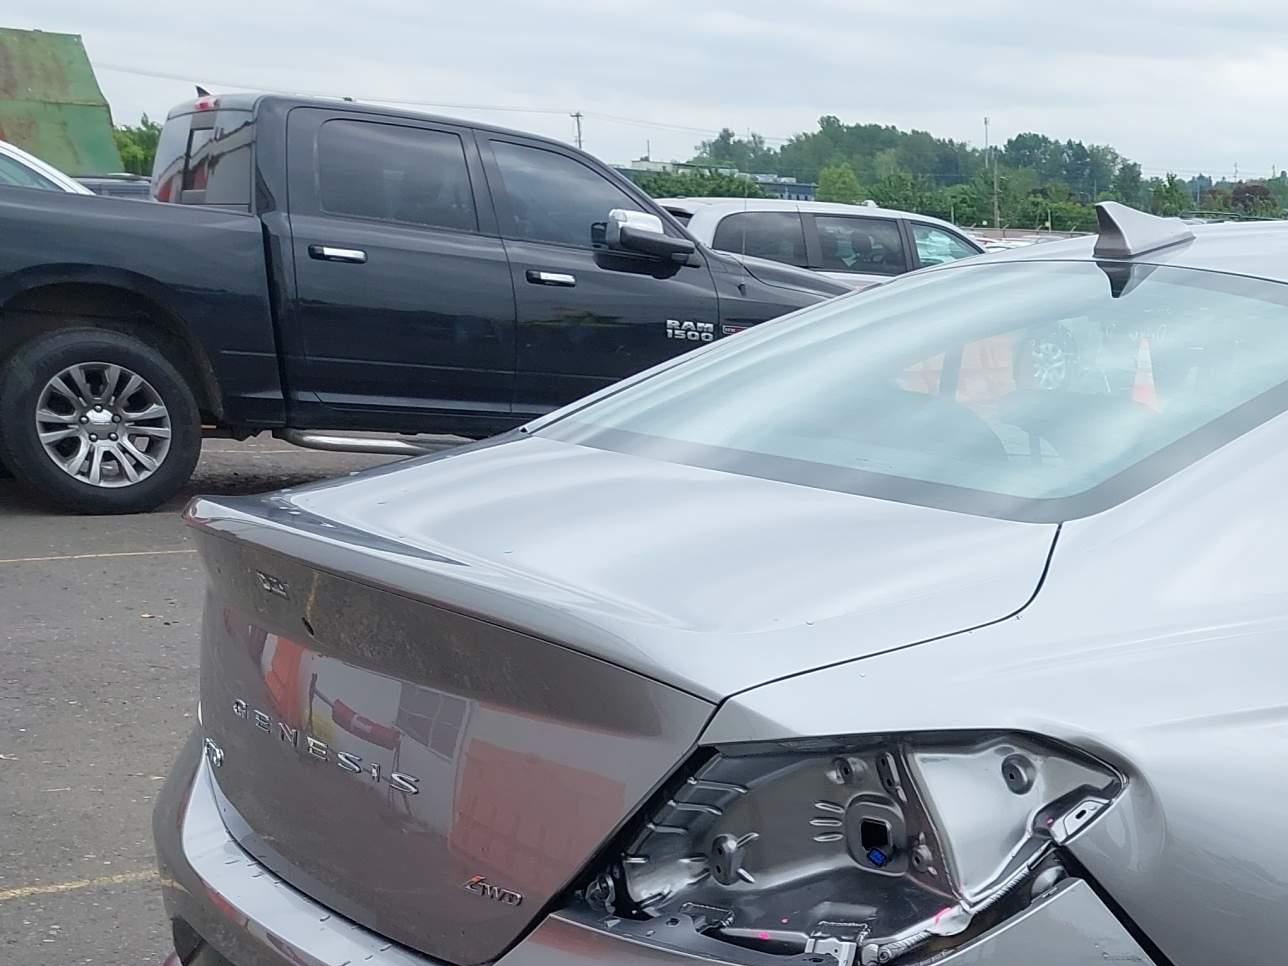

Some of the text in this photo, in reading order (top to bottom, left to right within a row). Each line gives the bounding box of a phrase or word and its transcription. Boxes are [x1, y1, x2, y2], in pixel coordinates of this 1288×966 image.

[666, 319, 714, 332] RAM
[666, 329, 714, 342] 1500
[233, 698, 420, 795] GENESIS
